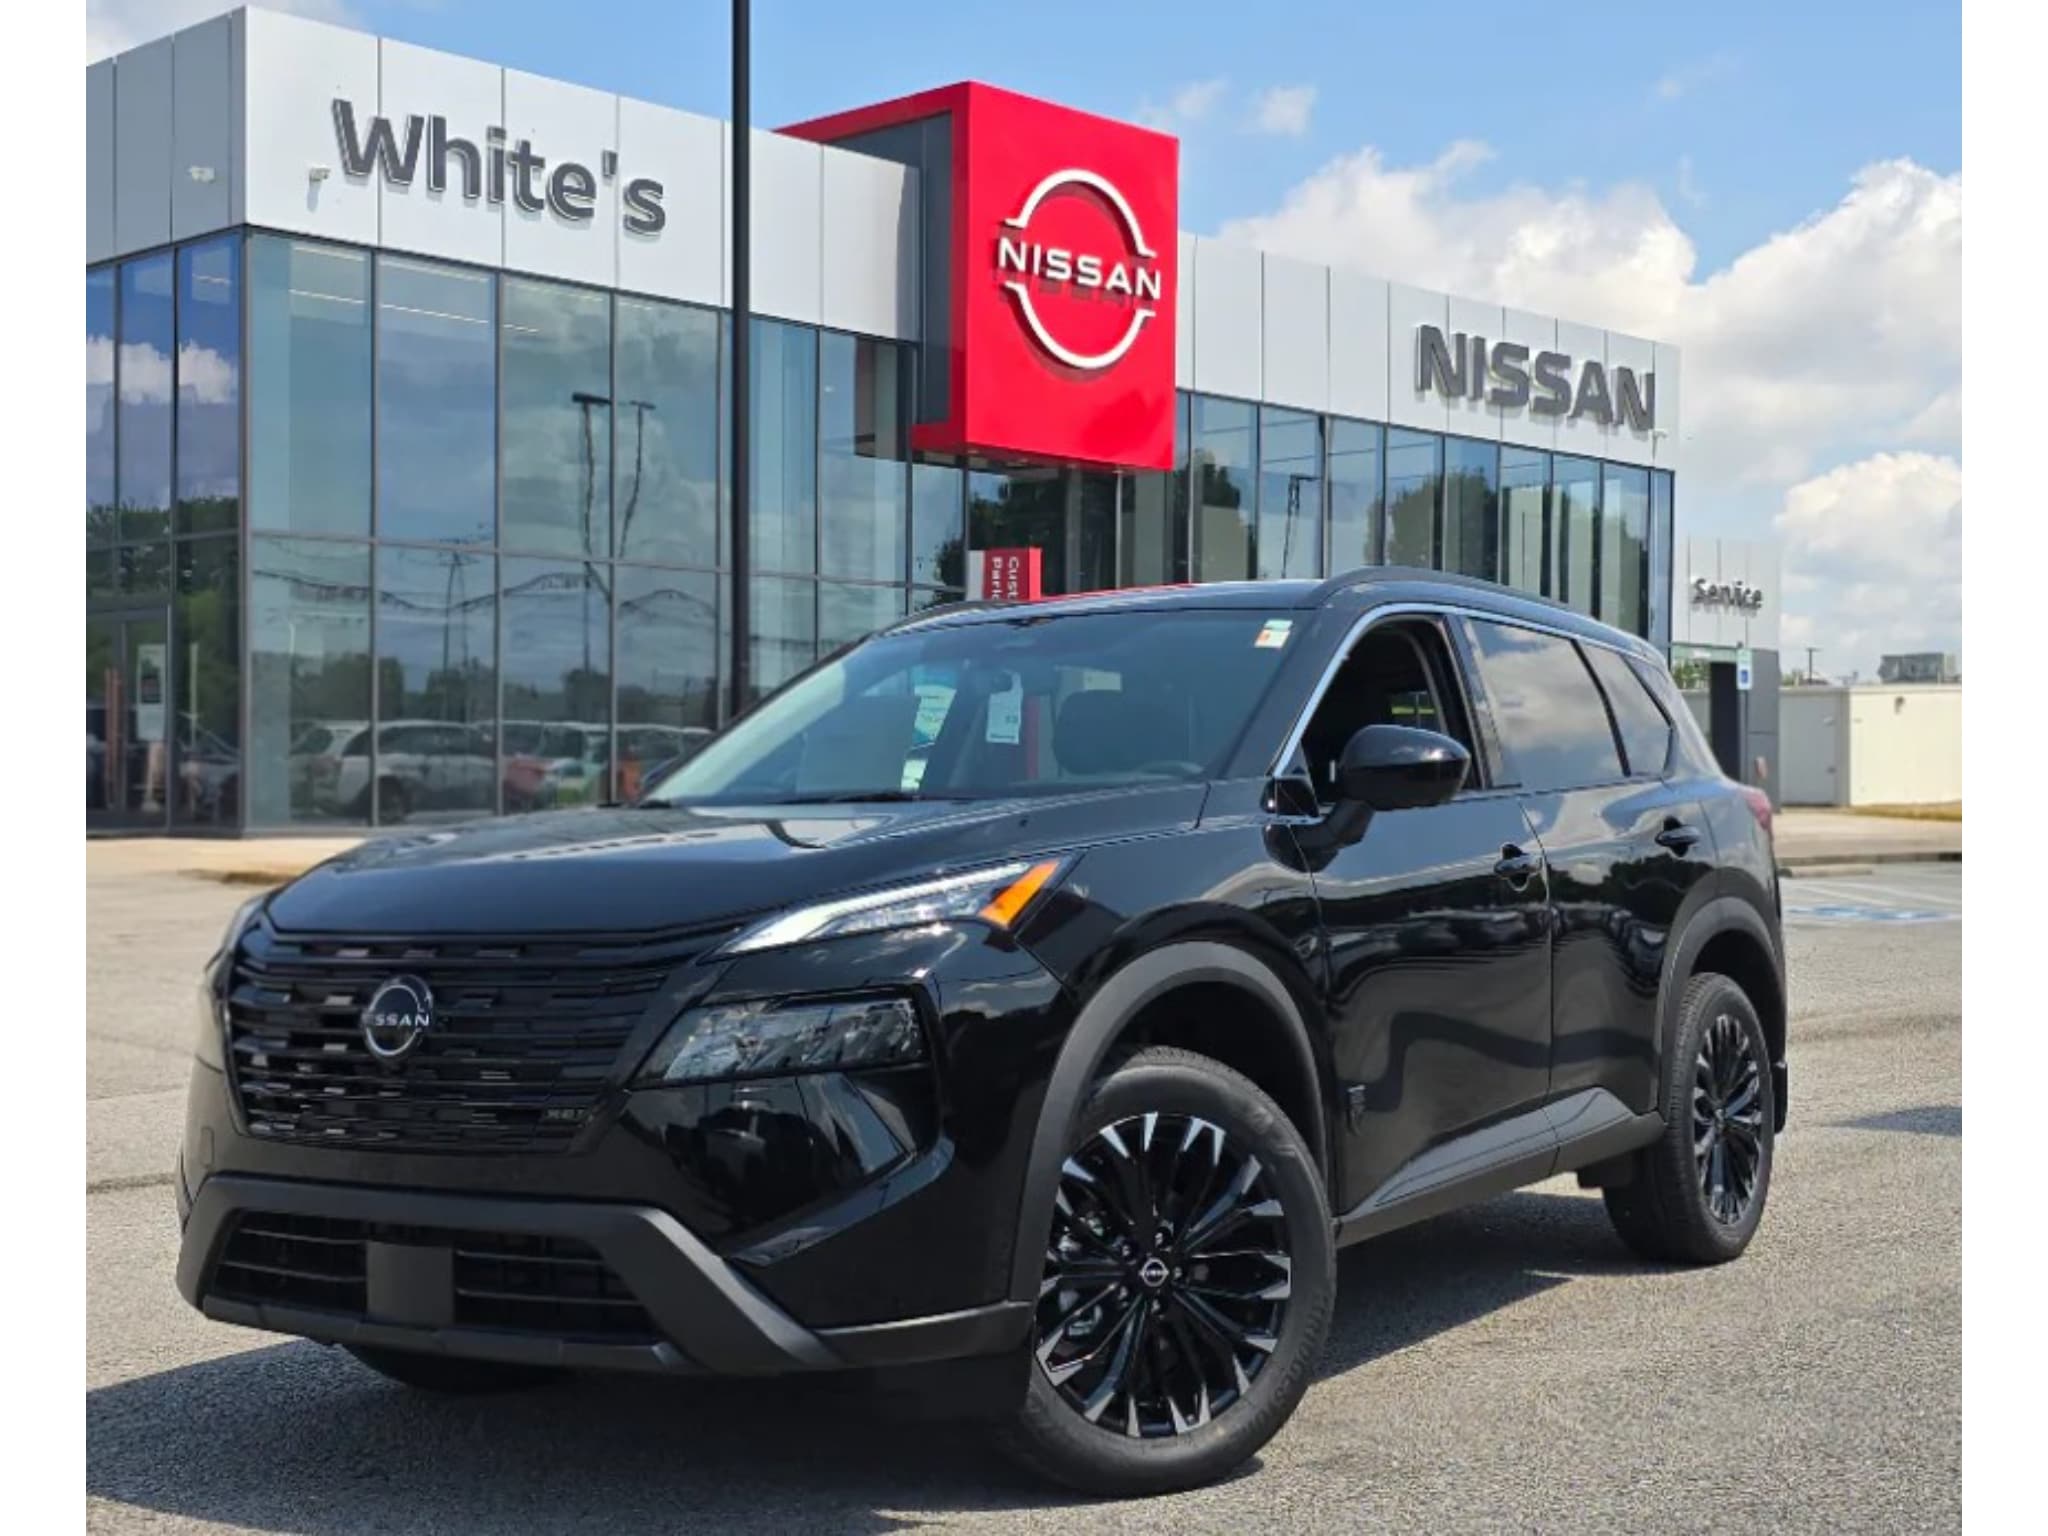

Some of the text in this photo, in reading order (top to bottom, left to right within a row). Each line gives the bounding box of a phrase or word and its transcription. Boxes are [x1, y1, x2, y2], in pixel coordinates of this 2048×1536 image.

[331, 99, 667, 237] White's
[998, 236, 1162, 300] NISSAN
[1416, 324, 1656, 432] NISSAN
[1691, 578, 1763, 609] Service
[360, 1013, 430, 1027] SSAN
